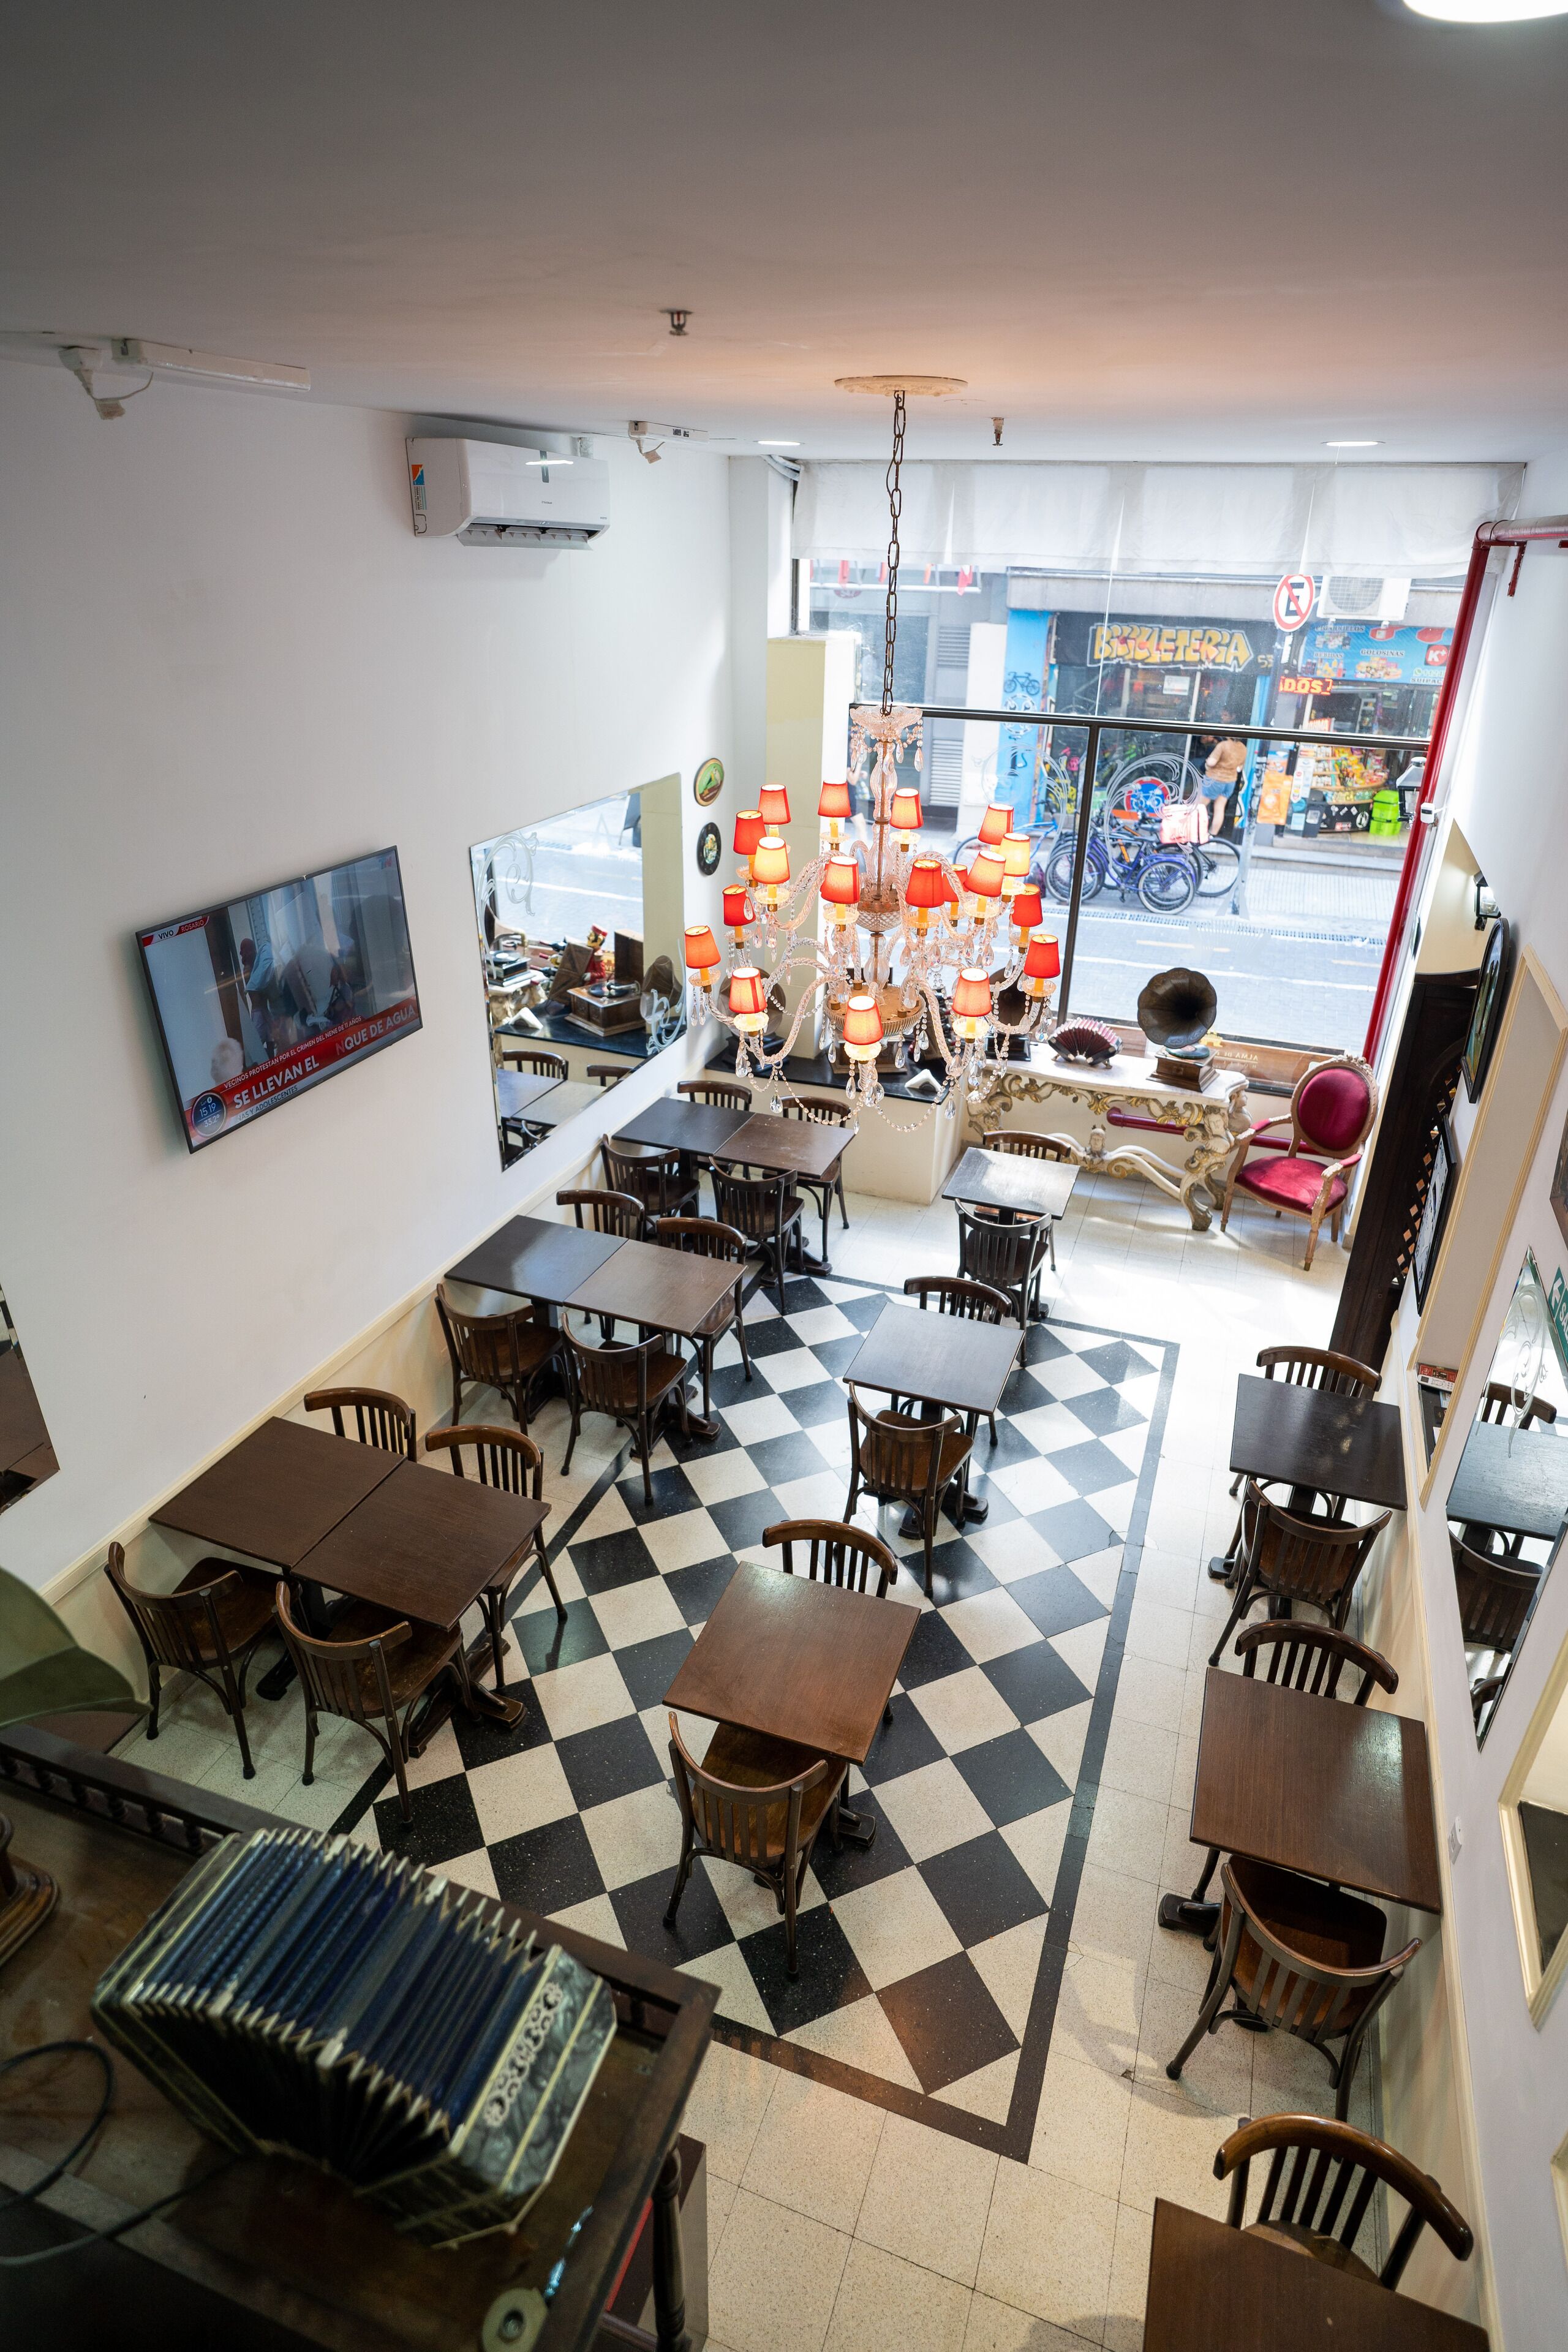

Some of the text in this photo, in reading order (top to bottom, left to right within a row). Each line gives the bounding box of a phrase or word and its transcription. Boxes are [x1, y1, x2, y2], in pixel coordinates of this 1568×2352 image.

[1285, 582, 1305, 616] E
[1360, 649, 1404, 657] GOLOSINAS
[159, 930, 174, 940] VIVO
[181, 921, 204, 932] ROSARIO
[224, 1072, 249, 1089] VECINOS
[249, 1058, 279, 1077] PROTESTAN
[279, 1052, 290, 1064] POR
[290, 1048, 296, 1057] EL
[296, 1038, 315, 1053] CRIMEN
[315, 1035, 325, 1044] DEL
[325, 1028, 338, 1040] NENE
[338, 1025, 345, 1034] DE
[348, 1016, 362, 1030] AÑOS
[234, 1091, 251, 1109] SE
[252, 1062, 303, 1099] LLEVAN
[306, 1055, 320, 1072] EL
[369, 1020, 384, 1038] DE
[386, 1005, 416, 1030] AGUA
[255, 1086, 298, 1111] ADOLESCENTES
